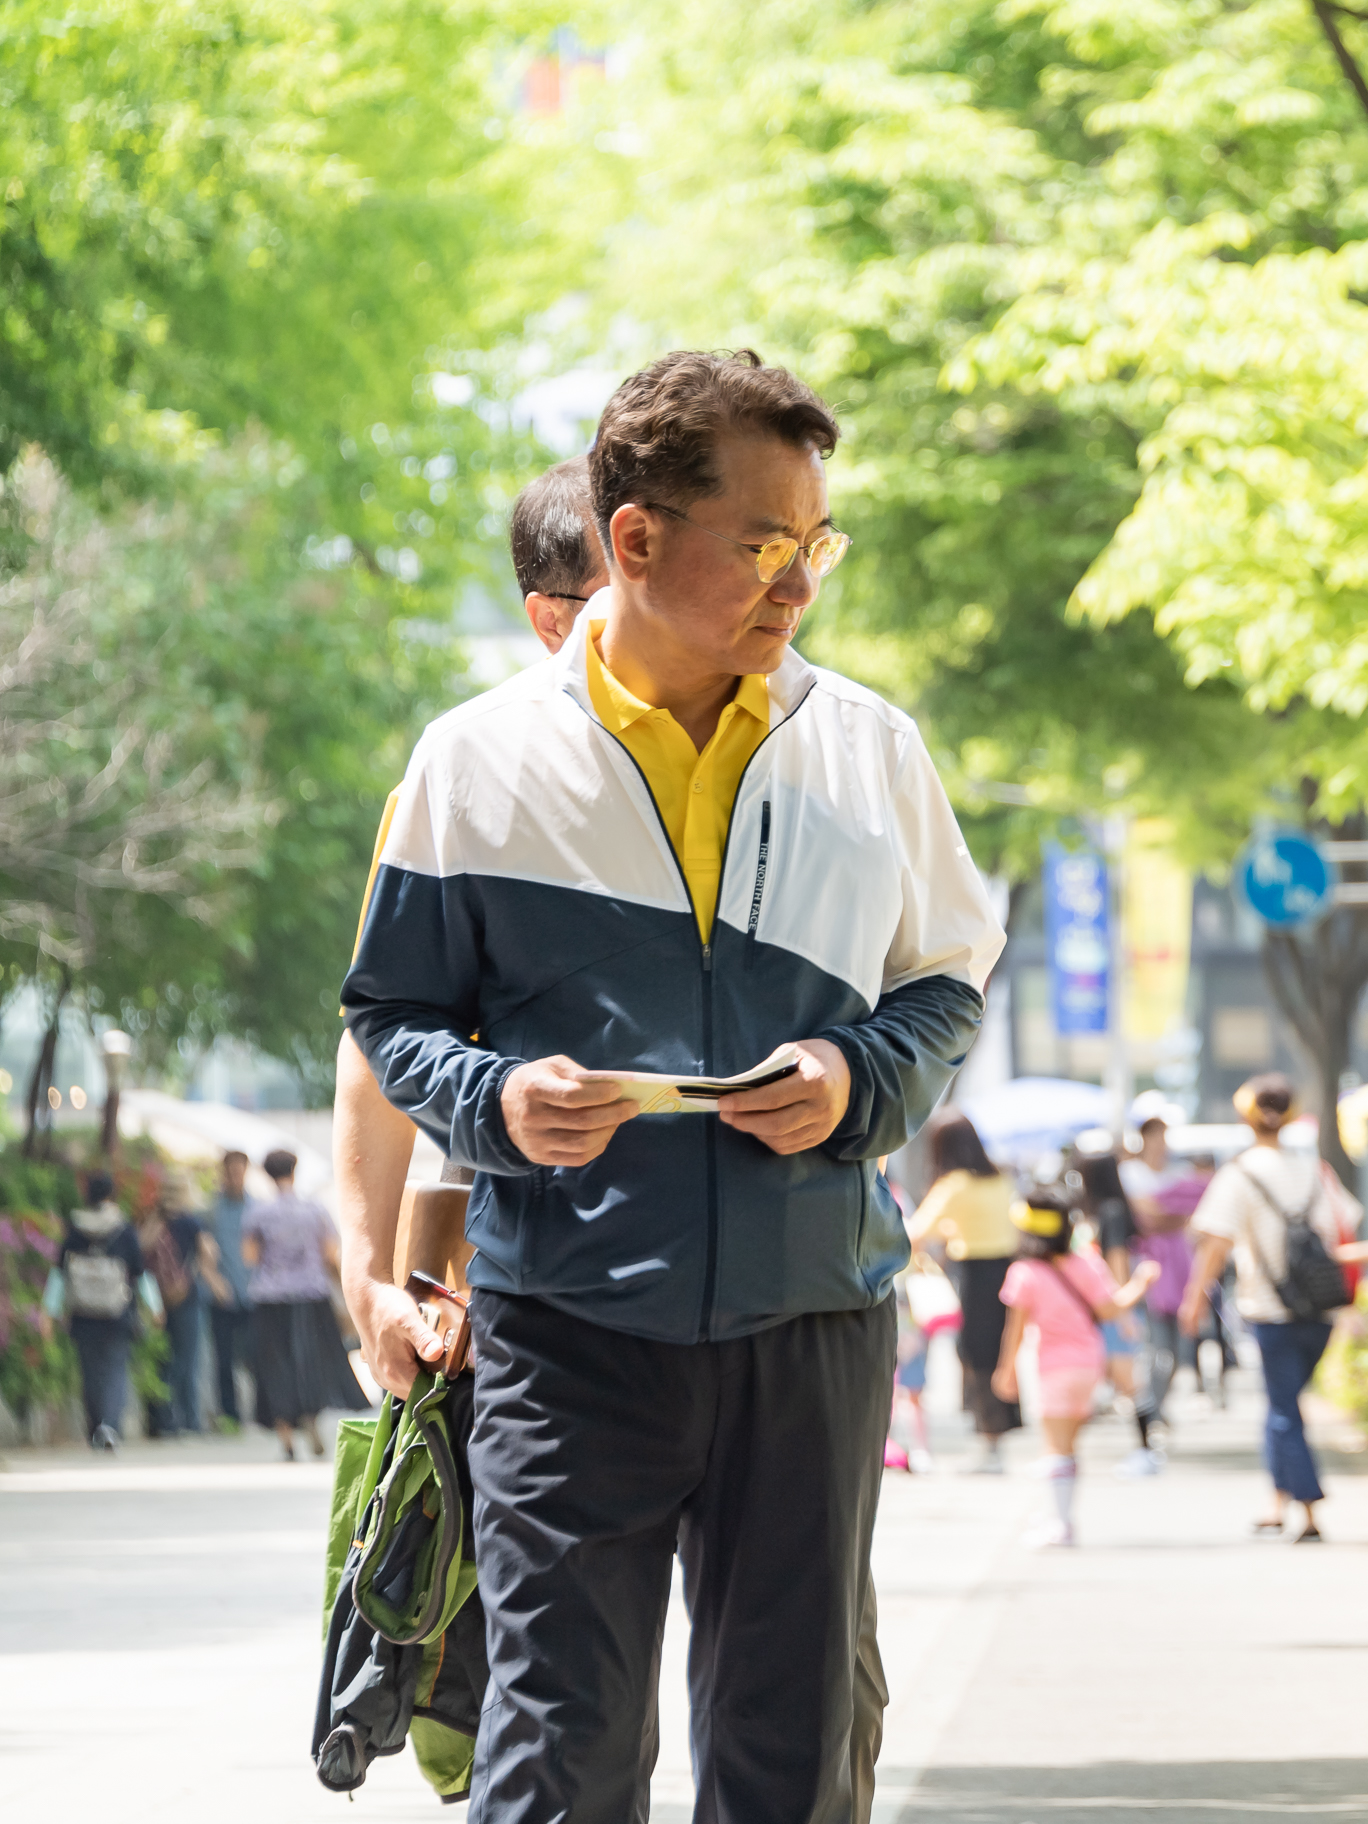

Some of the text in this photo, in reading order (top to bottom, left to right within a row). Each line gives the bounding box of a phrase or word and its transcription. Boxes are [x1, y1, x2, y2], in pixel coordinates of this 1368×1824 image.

[749, 843, 768, 930] THE NORTH FACE
